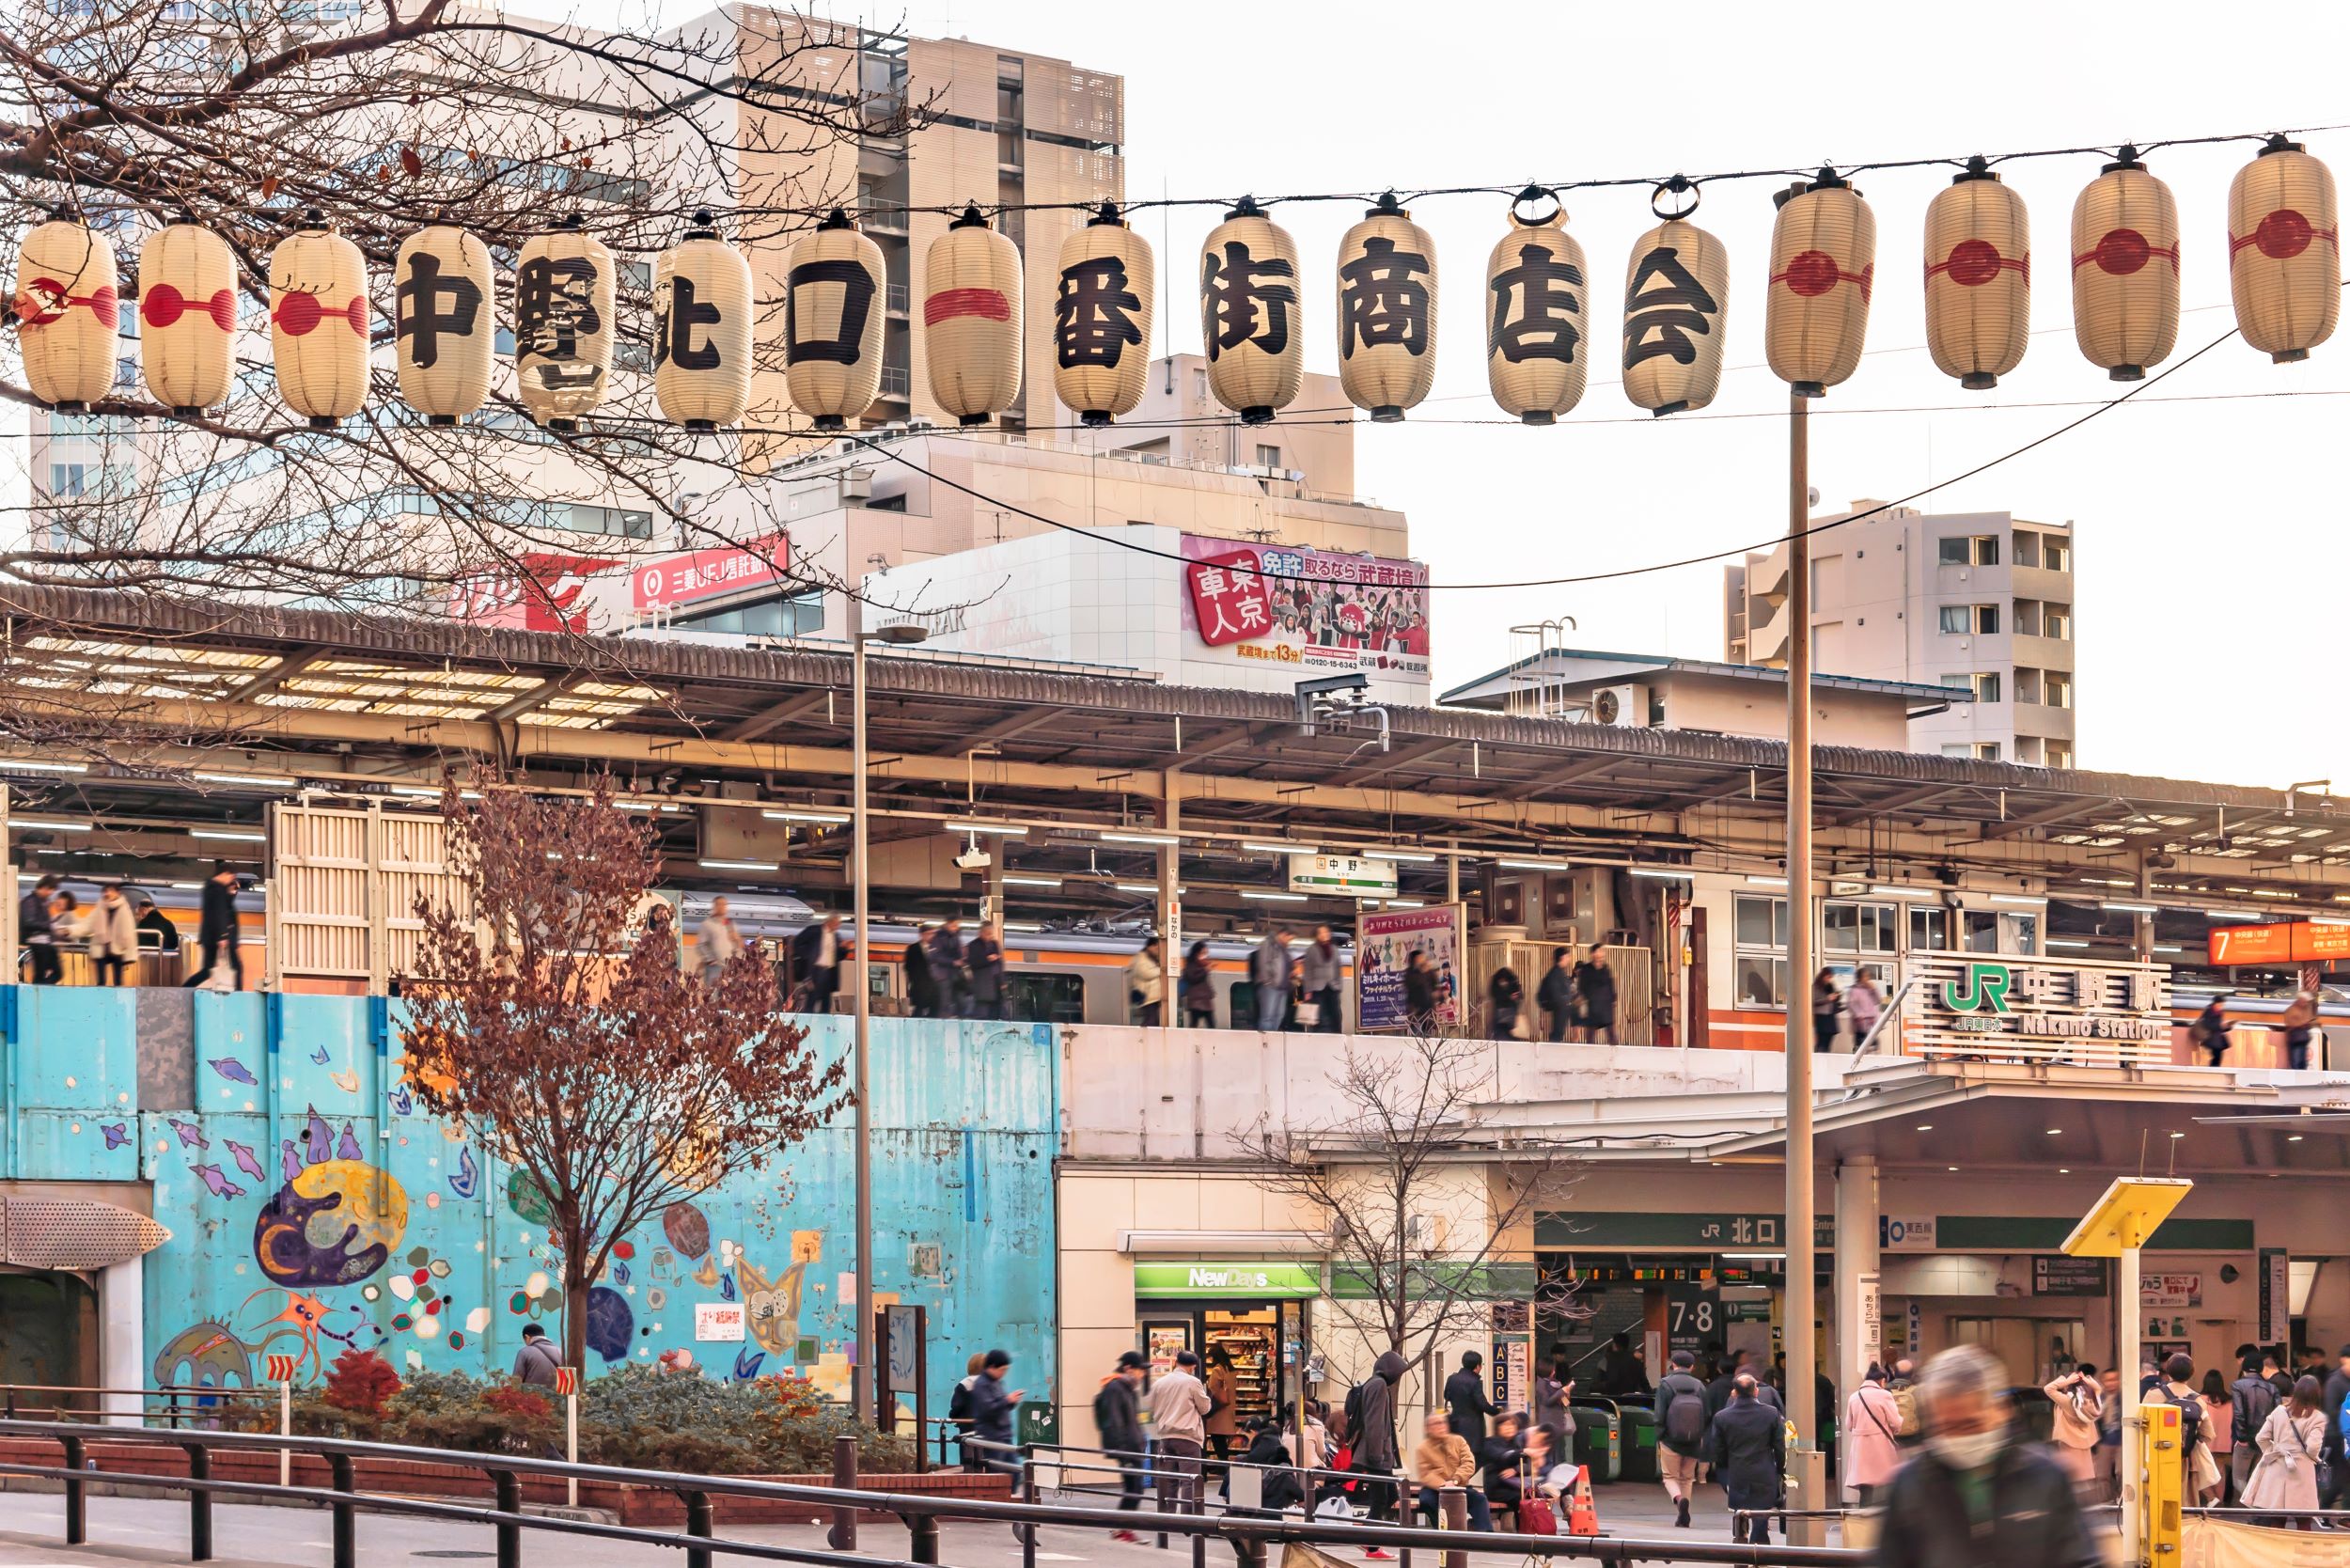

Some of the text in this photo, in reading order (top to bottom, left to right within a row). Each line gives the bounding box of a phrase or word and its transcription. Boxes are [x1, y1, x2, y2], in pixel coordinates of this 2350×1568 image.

[1310, 657, 1357, 669] 0120-15-6343
[1329, 858, 1357, 871] 中野
[2215, 932, 2230, 960] 7
[1942, 963, 2162, 1012] JR 中野駅
[1956, 1017, 2003, 1033] JR東日本
[2020, 1015, 2162, 1040] Nakano Station
[1701, 1224, 1720, 1238] JR
[1731, 1218, 1776, 1244] 北口
[1188, 1268, 1267, 1288] NewDays
[1496, 1346, 1505, 1360] A
[1496, 1366, 1505, 1380] B
[1496, 1386, 1505, 1400] C
